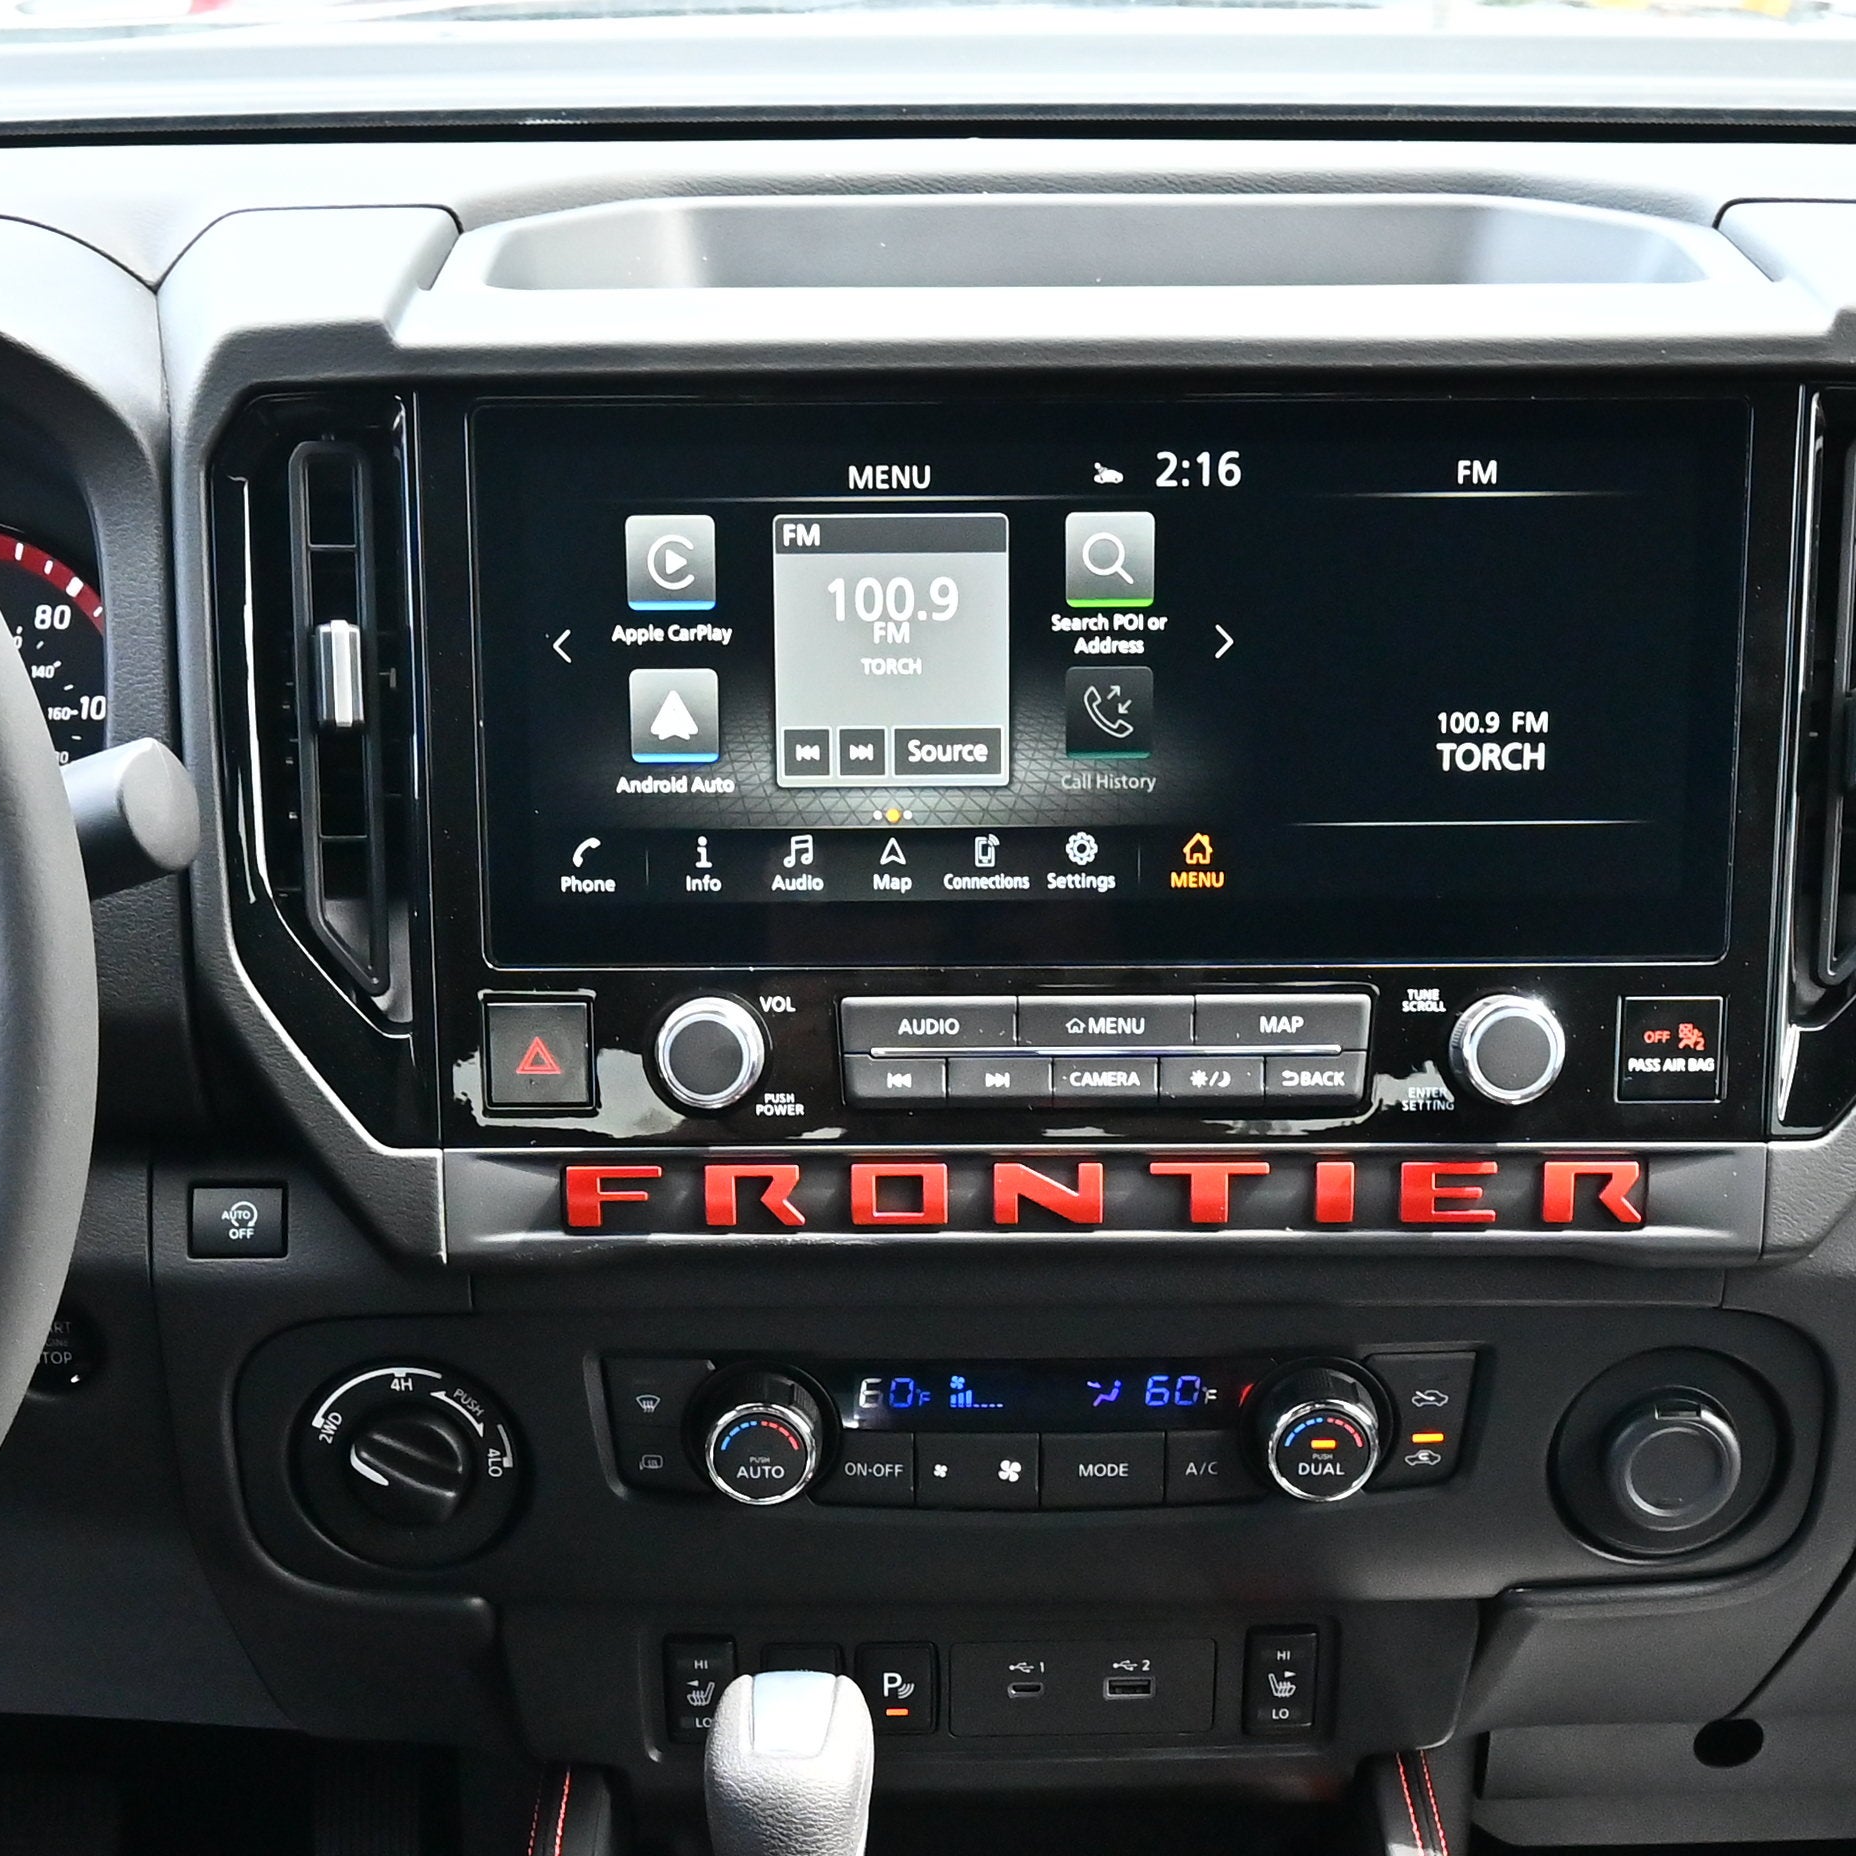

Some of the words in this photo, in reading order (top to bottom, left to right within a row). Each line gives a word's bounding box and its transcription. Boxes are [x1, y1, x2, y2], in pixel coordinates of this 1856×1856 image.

[847, 464, 932, 491] MENU
[1155, 451, 1243, 488] 2:16
[1456, 460, 1498, 486] FM
[783, 524, 822, 546] FM
[826, 577, 960, 623] 100.9
[34, 604, 72, 630] 80
[1050, 613, 1108, 633] Search
[1112, 613, 1145, 632] POI
[1147, 616, 1168, 632] or
[611, 624, 665, 645] Apple
[669, 624, 733, 645] CarPlay
[873, 621, 911, 645] FM
[1074, 635, 1145, 655] Address
[31, 665, 55, 679] 140
[860, 657, 923, 675] TORCH
[1437, 711, 1500, 735] 100.9
[1512, 711, 1549, 735] FM
[907, 739, 989, 763] Source
[1436, 741, 1546, 772] TORCH
[616, 775, 688, 794] Android
[692, 775, 735, 794] Auto
[1060, 773, 1091, 791] Call
[1095, 773, 1157, 793] History
[560, 875, 616, 893] Phone
[686, 874, 722, 893] Info
[771, 874, 824, 892] Audio
[873, 874, 913, 895] Map
[943, 872, 1030, 891] Connections
[1046, 871, 1116, 893] Settings
[1170, 870, 1225, 889] MENU
[759, 996, 796, 1013] VOL
[1407, 989, 1440, 1002] TUNE
[1402, 1001, 1446, 1013] SCROLL
[898, 1018, 960, 1036] AUDIO
[1088, 1017, 1145, 1035] MENU
[1259, 1016, 1304, 1035] MAP
[1644, 1031, 1671, 1045] OFF
[1628, 1058, 1658, 1072] PASS
[1662, 1058, 1686, 1072] AIR
[1688, 1057, 1715, 1072] BAG
[1069, 1072, 1140, 1088] CAMERA
[1300, 1071, 1345, 1088] BACK
[764, 1093, 795, 1103] PUSH
[1408, 1086, 1446, 1099] ENTER
[755, 1104, 805, 1116] POWER
[1401, 1099, 1455, 1112] SETTING
[564, 1161, 1642, 1227] FRONTIER
[221, 1210, 251, 1220] AUTO
[228, 1228, 255, 1240] OFF
[390, 1377, 413, 1392] 4H
[452, 1387, 485, 1418] PUSH
[318, 1411, 343, 1445] 2WD
[487, 1448, 503, 1478] 4LO
[736, 1465, 785, 1479] AUTO
[1078, 1463, 1129, 1477] MODE
[1185, 1460, 1219, 1476] A/C
[1298, 1462, 1345, 1476] DUAL
[1275, 1649, 1291, 1661] HI
[694, 1659, 709, 1670] HI
[1142, 1659, 1151, 1671] 2
[1272, 1707, 1290, 1720] LO
